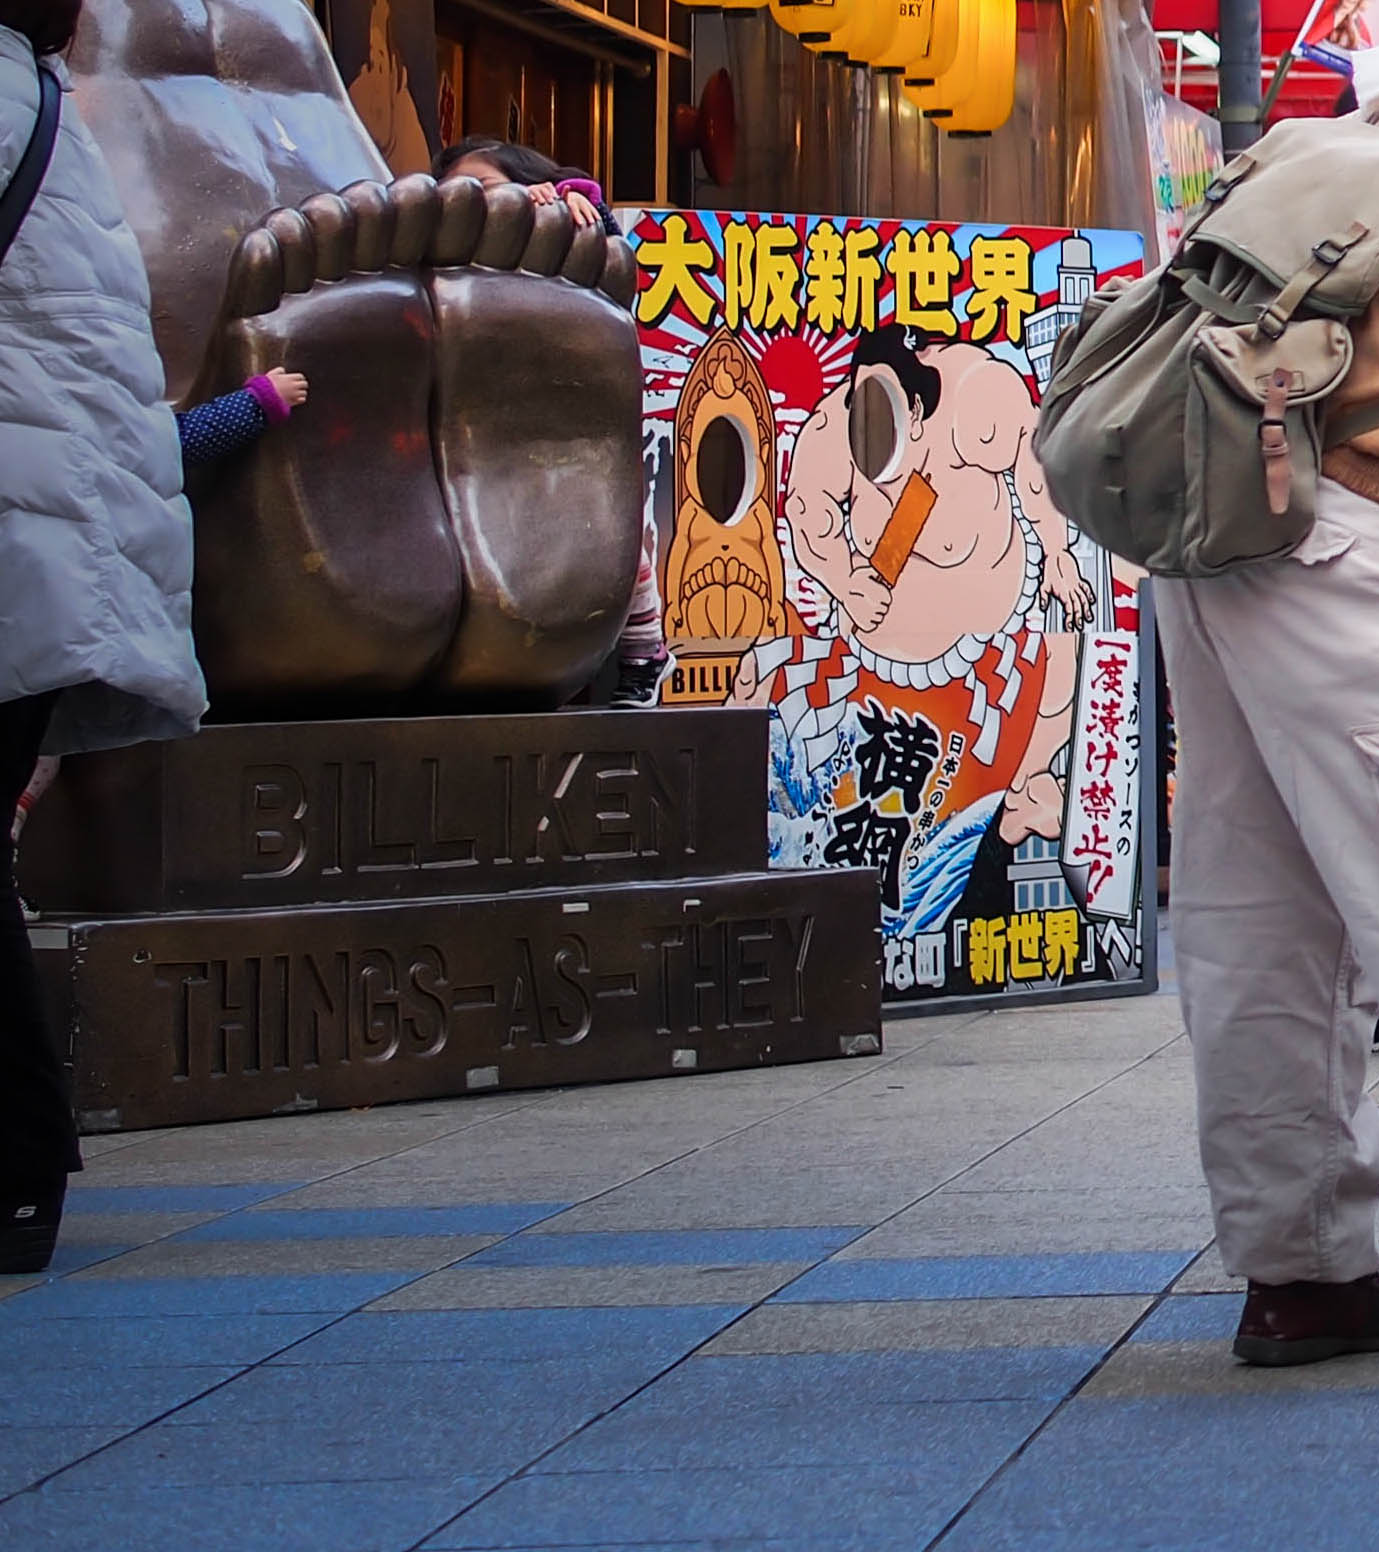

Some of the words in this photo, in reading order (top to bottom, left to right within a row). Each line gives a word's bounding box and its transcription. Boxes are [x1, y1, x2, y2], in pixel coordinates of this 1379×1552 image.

[636, 215, 1038, 343] 大阪新世界
[671, 666, 736, 696] BILLI
[243, 748, 698, 881] BILLIKEN
[907, 734, 964, 871] 日本一の串かつ
